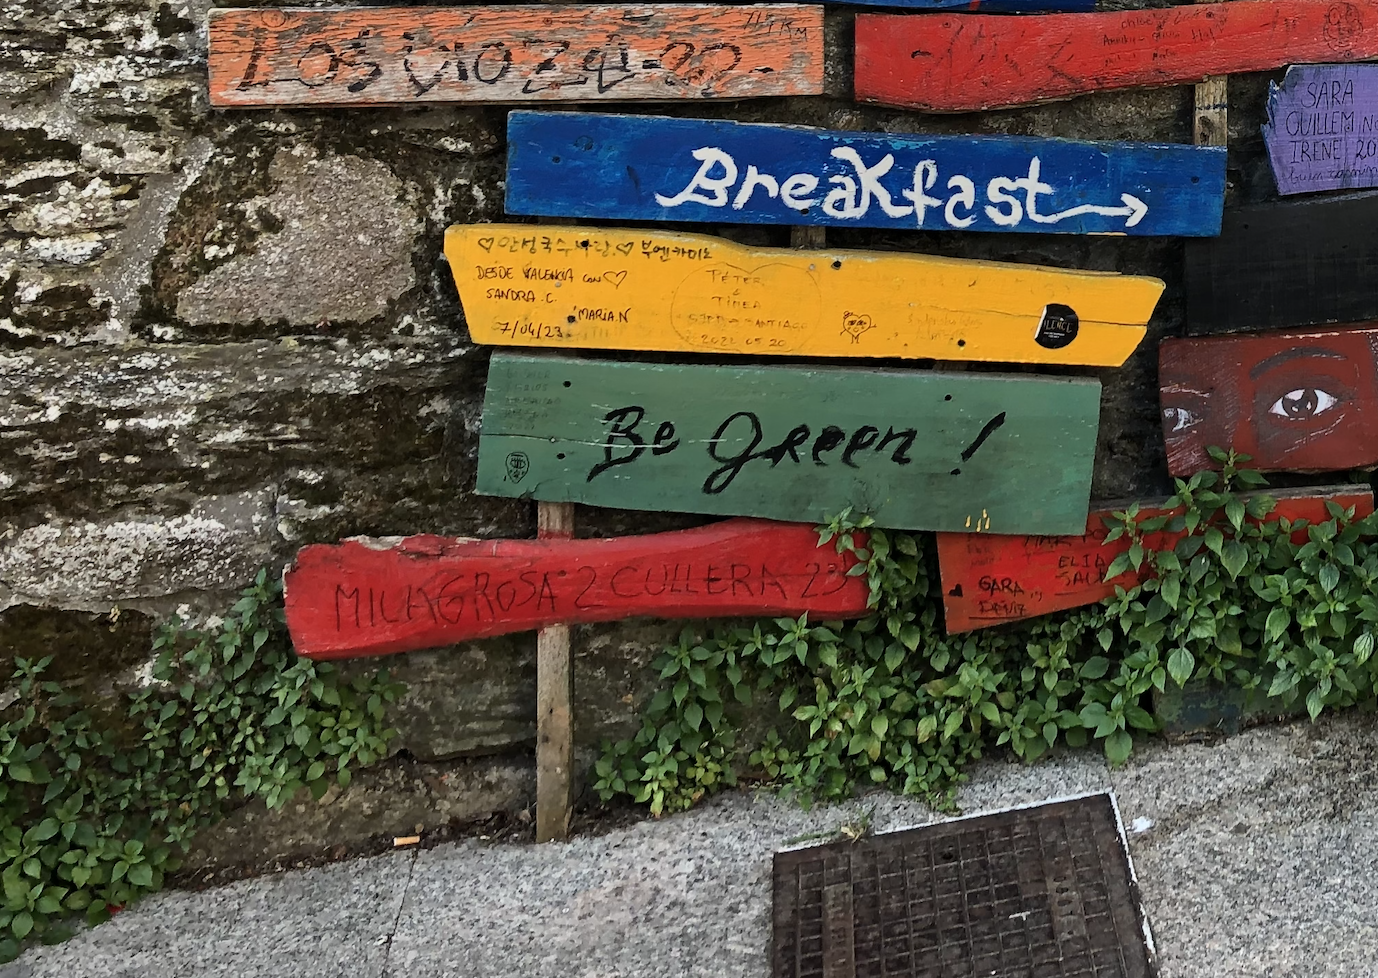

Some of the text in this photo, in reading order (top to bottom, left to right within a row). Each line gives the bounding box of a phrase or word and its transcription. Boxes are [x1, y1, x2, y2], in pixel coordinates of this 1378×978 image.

[1301, 79, 1354, 110] SARA
[1289, 139, 1342, 164] IRENE
[586, 404, 682, 483] Be
